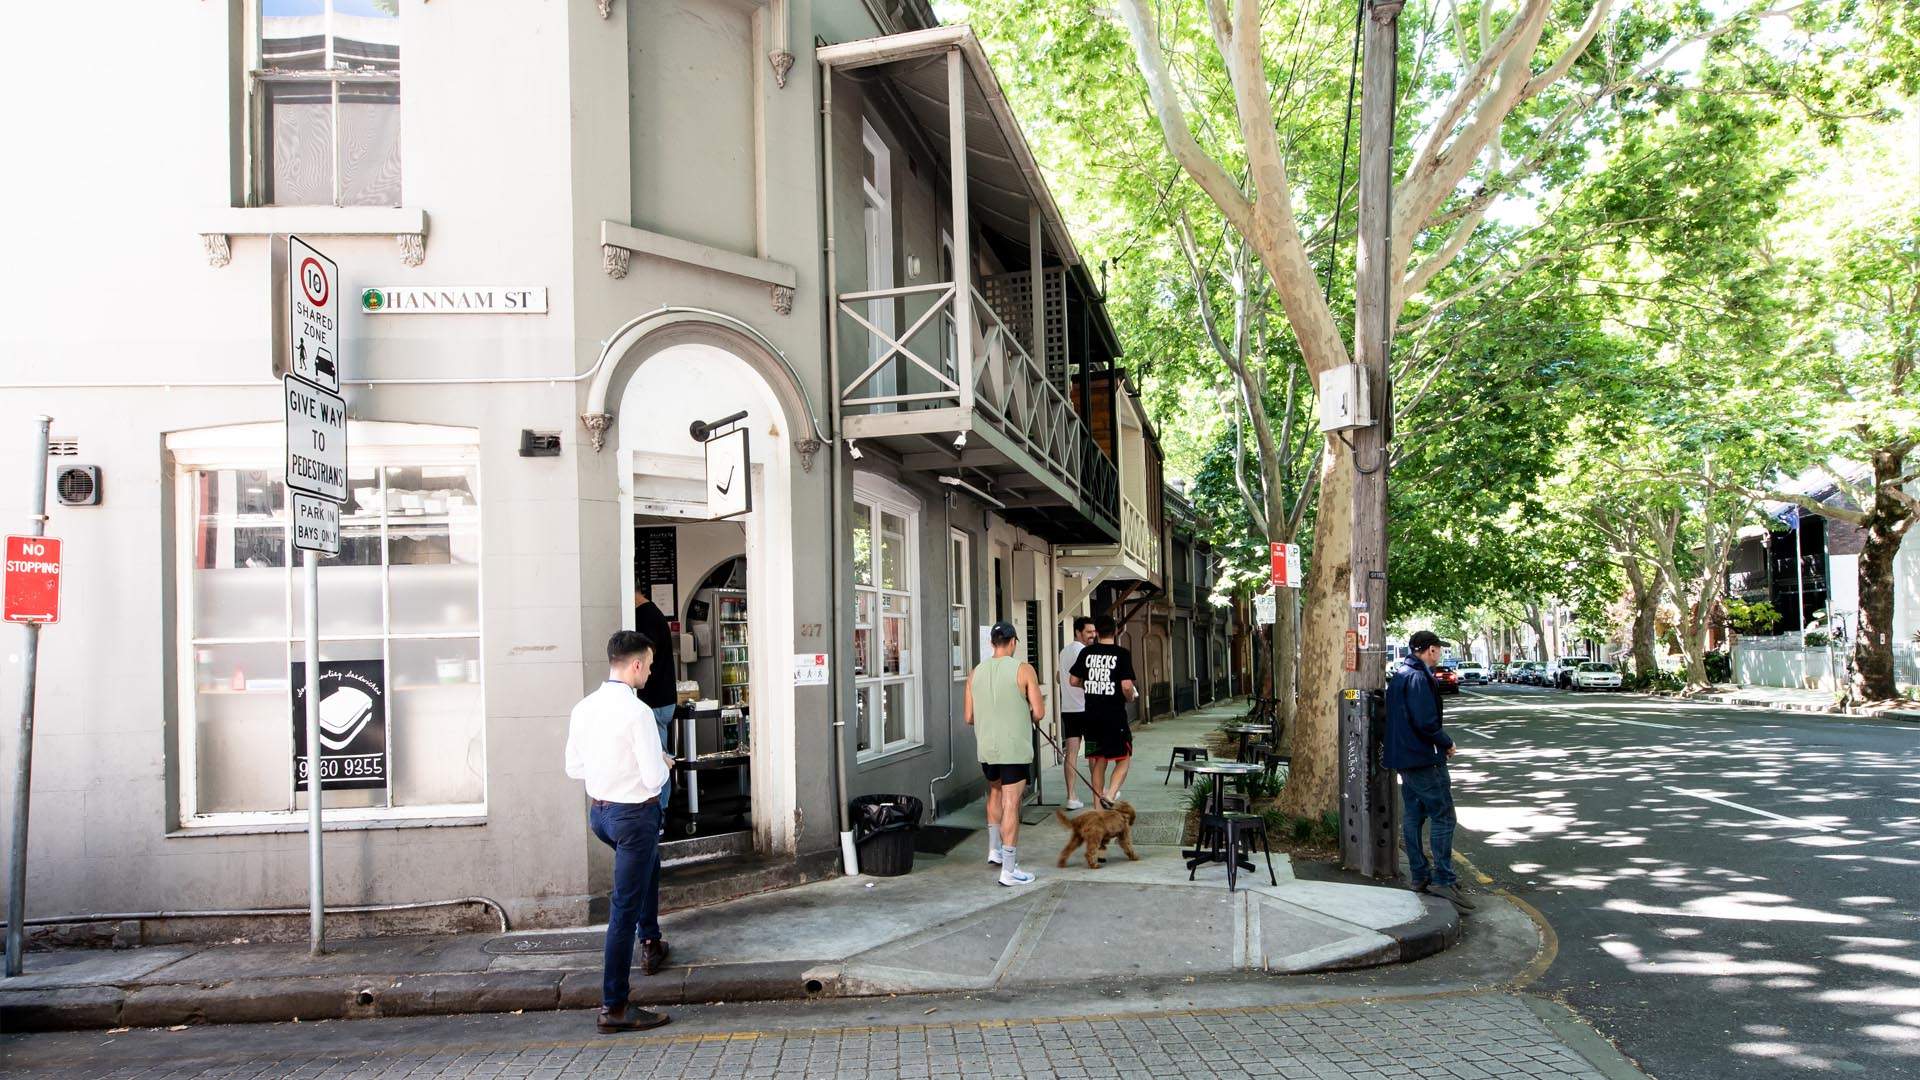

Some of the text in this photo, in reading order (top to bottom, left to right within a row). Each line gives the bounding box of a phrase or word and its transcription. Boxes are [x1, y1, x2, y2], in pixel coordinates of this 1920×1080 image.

[308, 269, 321, 294] 10
[386, 291, 532, 309] HANNAM ST
[297, 302, 333, 331] SHARED
[304, 322, 327, 345] ZONE
[290, 390, 343, 429] GIVE WAY
[312, 429, 325, 452] TO
[292, 453, 343, 488] PEDESTRIANS
[301, 504, 335, 523] PARK IN
[298, 525, 337, 545] BAYS ONLY
[23, 544, 45, 556] NO
[7, 560, 59, 574] STOPPING
[1086, 655, 1117, 669] CHECKS
[1089, 668, 1110, 681] OVER
[1084, 681, 1115, 695] STRIPES
[299, 758, 383, 778] 960 9355
